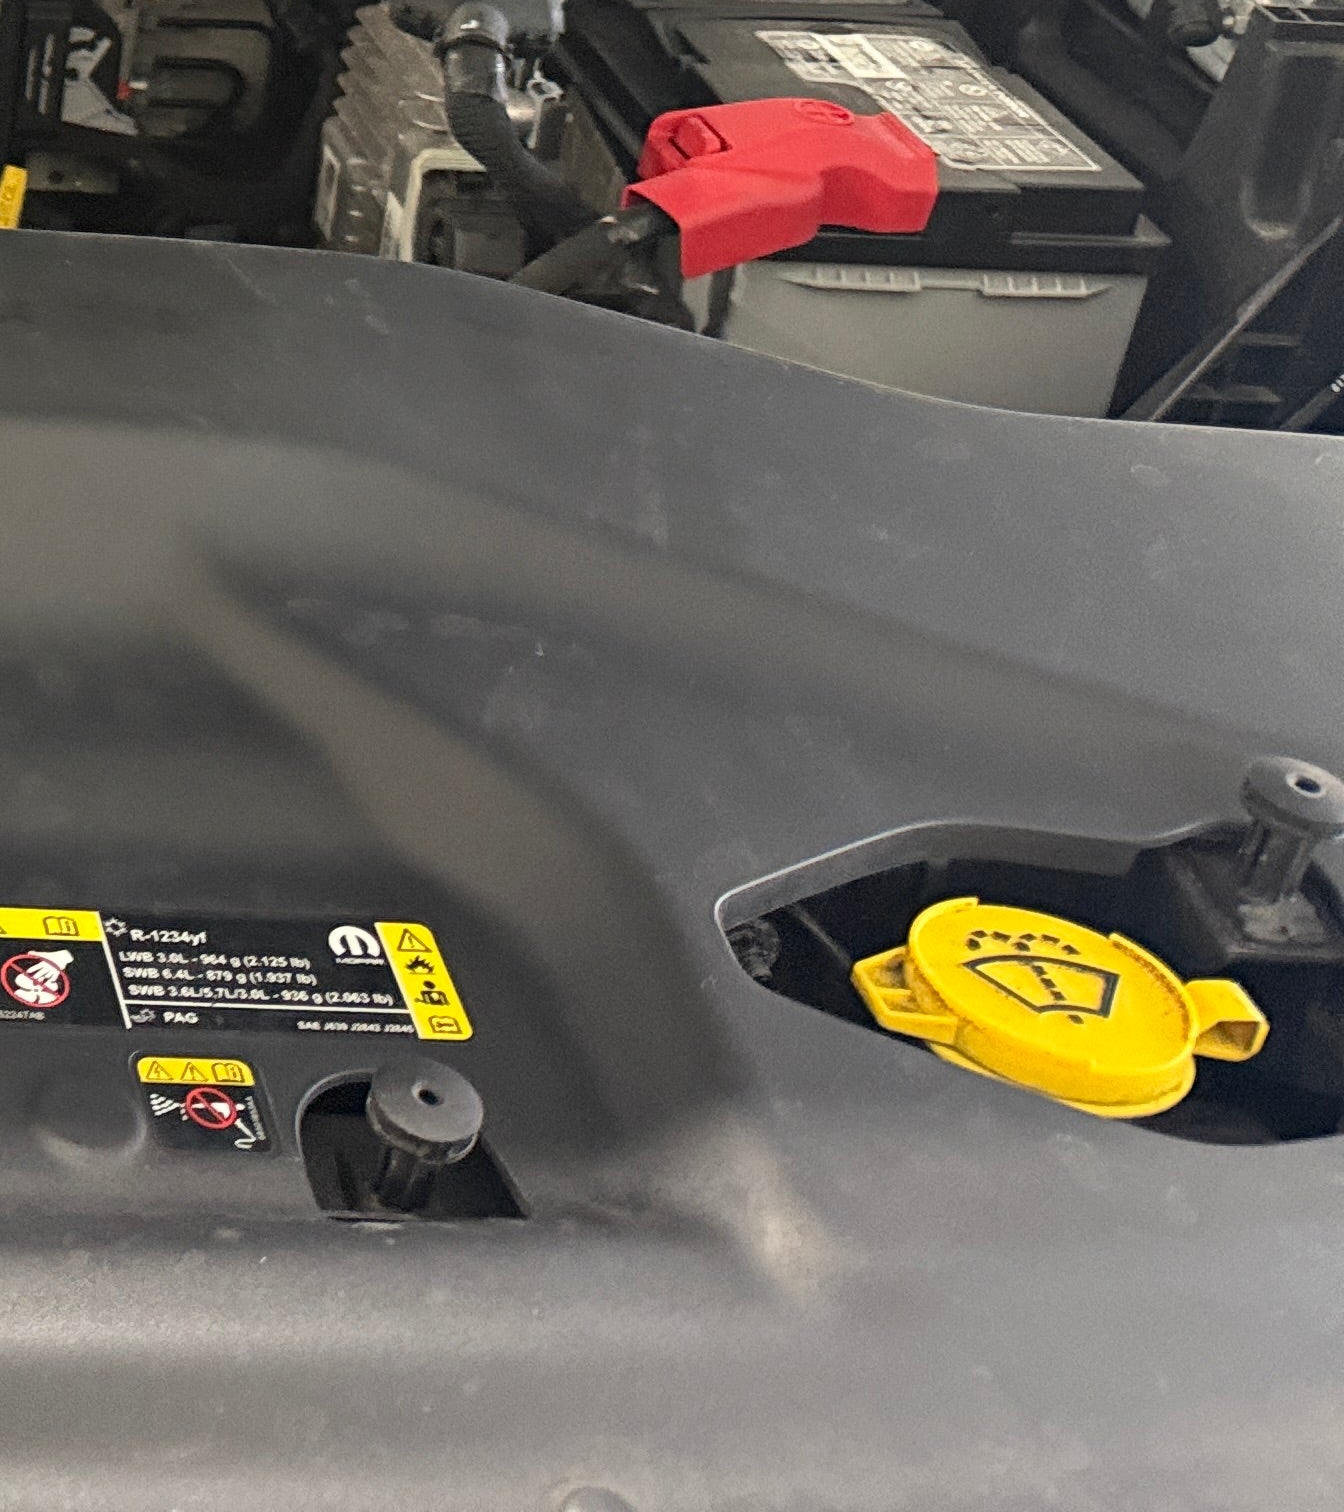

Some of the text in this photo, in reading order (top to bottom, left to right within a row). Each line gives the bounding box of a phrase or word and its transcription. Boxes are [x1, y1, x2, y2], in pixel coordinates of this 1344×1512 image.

[118, 950, 154, 963] LWB
[230, 956, 241, 968] g
[243, 955, 288, 968] (2.125
[289, 956, 311, 970] lb)
[122, 966, 160, 979] SWB
[235, 972, 247, 984] g
[295, 972, 318, 987] lb)
[127, 983, 165, 996] SWB
[312, 992, 324, 1005] g
[372, 993, 394, 1007] lb)
[162, 1011, 200, 1024] PAG
